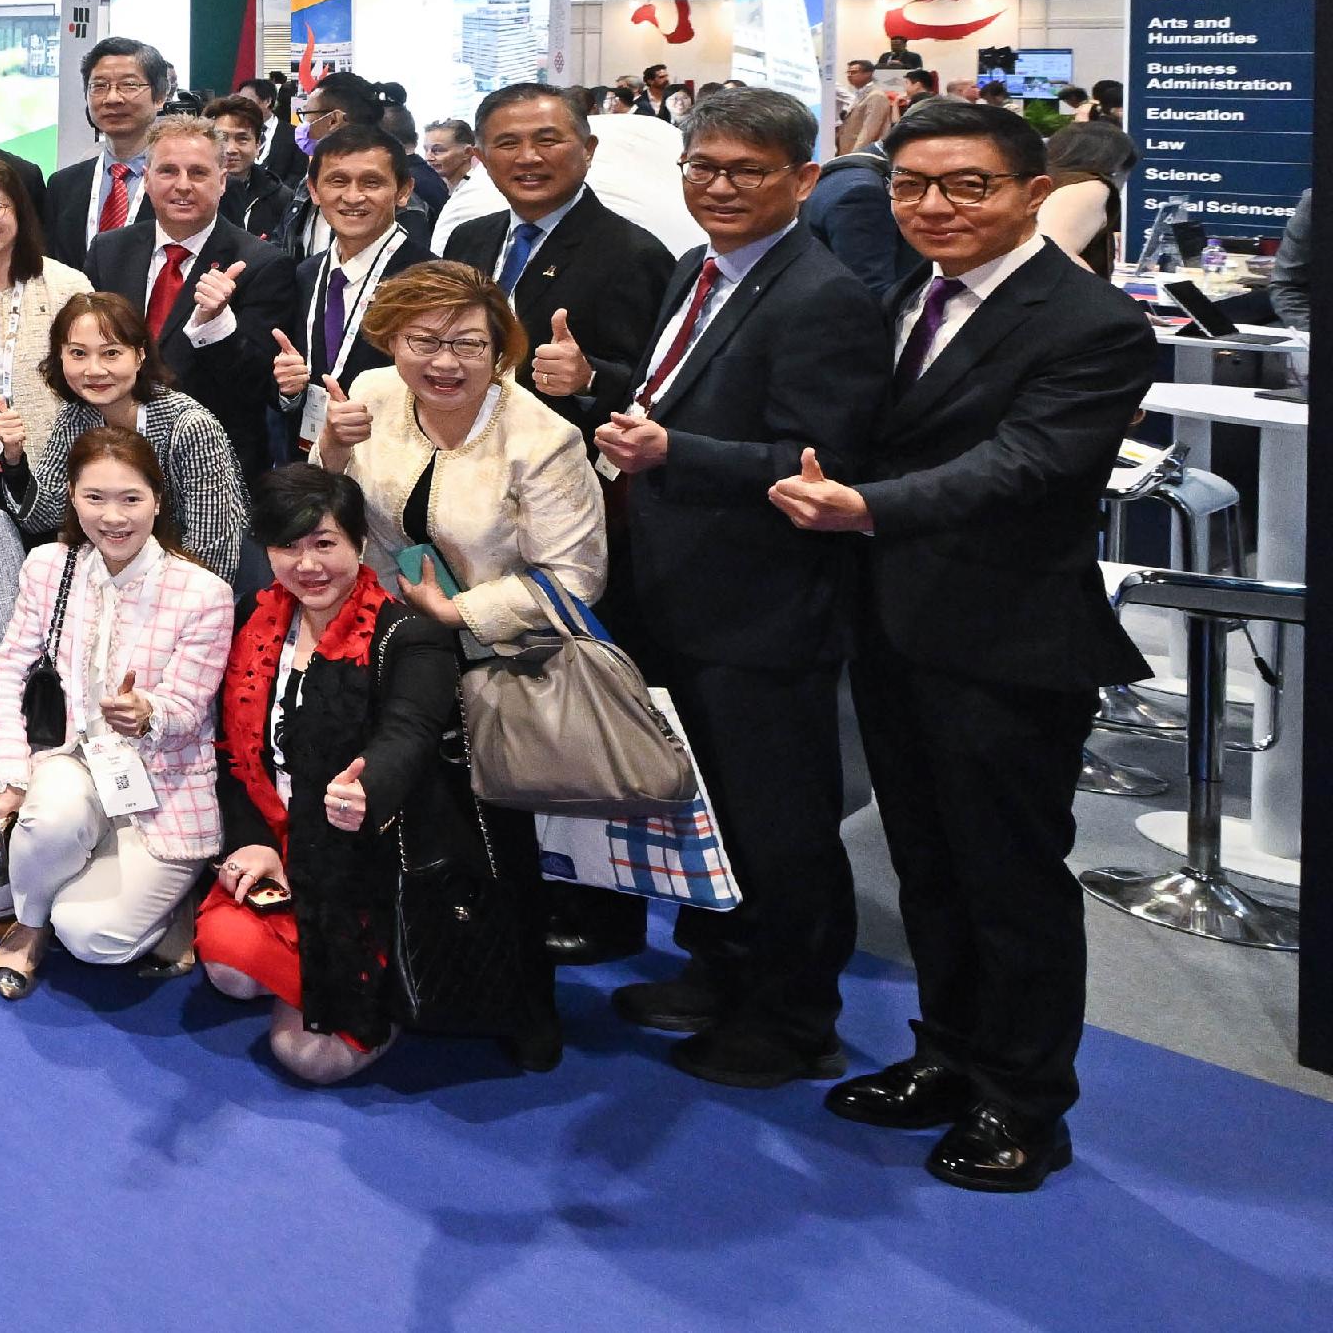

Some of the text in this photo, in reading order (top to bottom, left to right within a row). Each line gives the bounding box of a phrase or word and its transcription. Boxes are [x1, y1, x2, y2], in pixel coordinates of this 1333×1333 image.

[1148, 16, 1230, 30] Arts and
[1148, 31, 1258, 45] Humanities
[1148, 62, 1238, 76] Business
[1147, 77, 1292, 92] Administration
[1146, 108, 1244, 122] Education
[1146, 138, 1185, 152] Law
[1145, 168, 1222, 182] Science
[1207, 201, 1296, 217] Sciences
